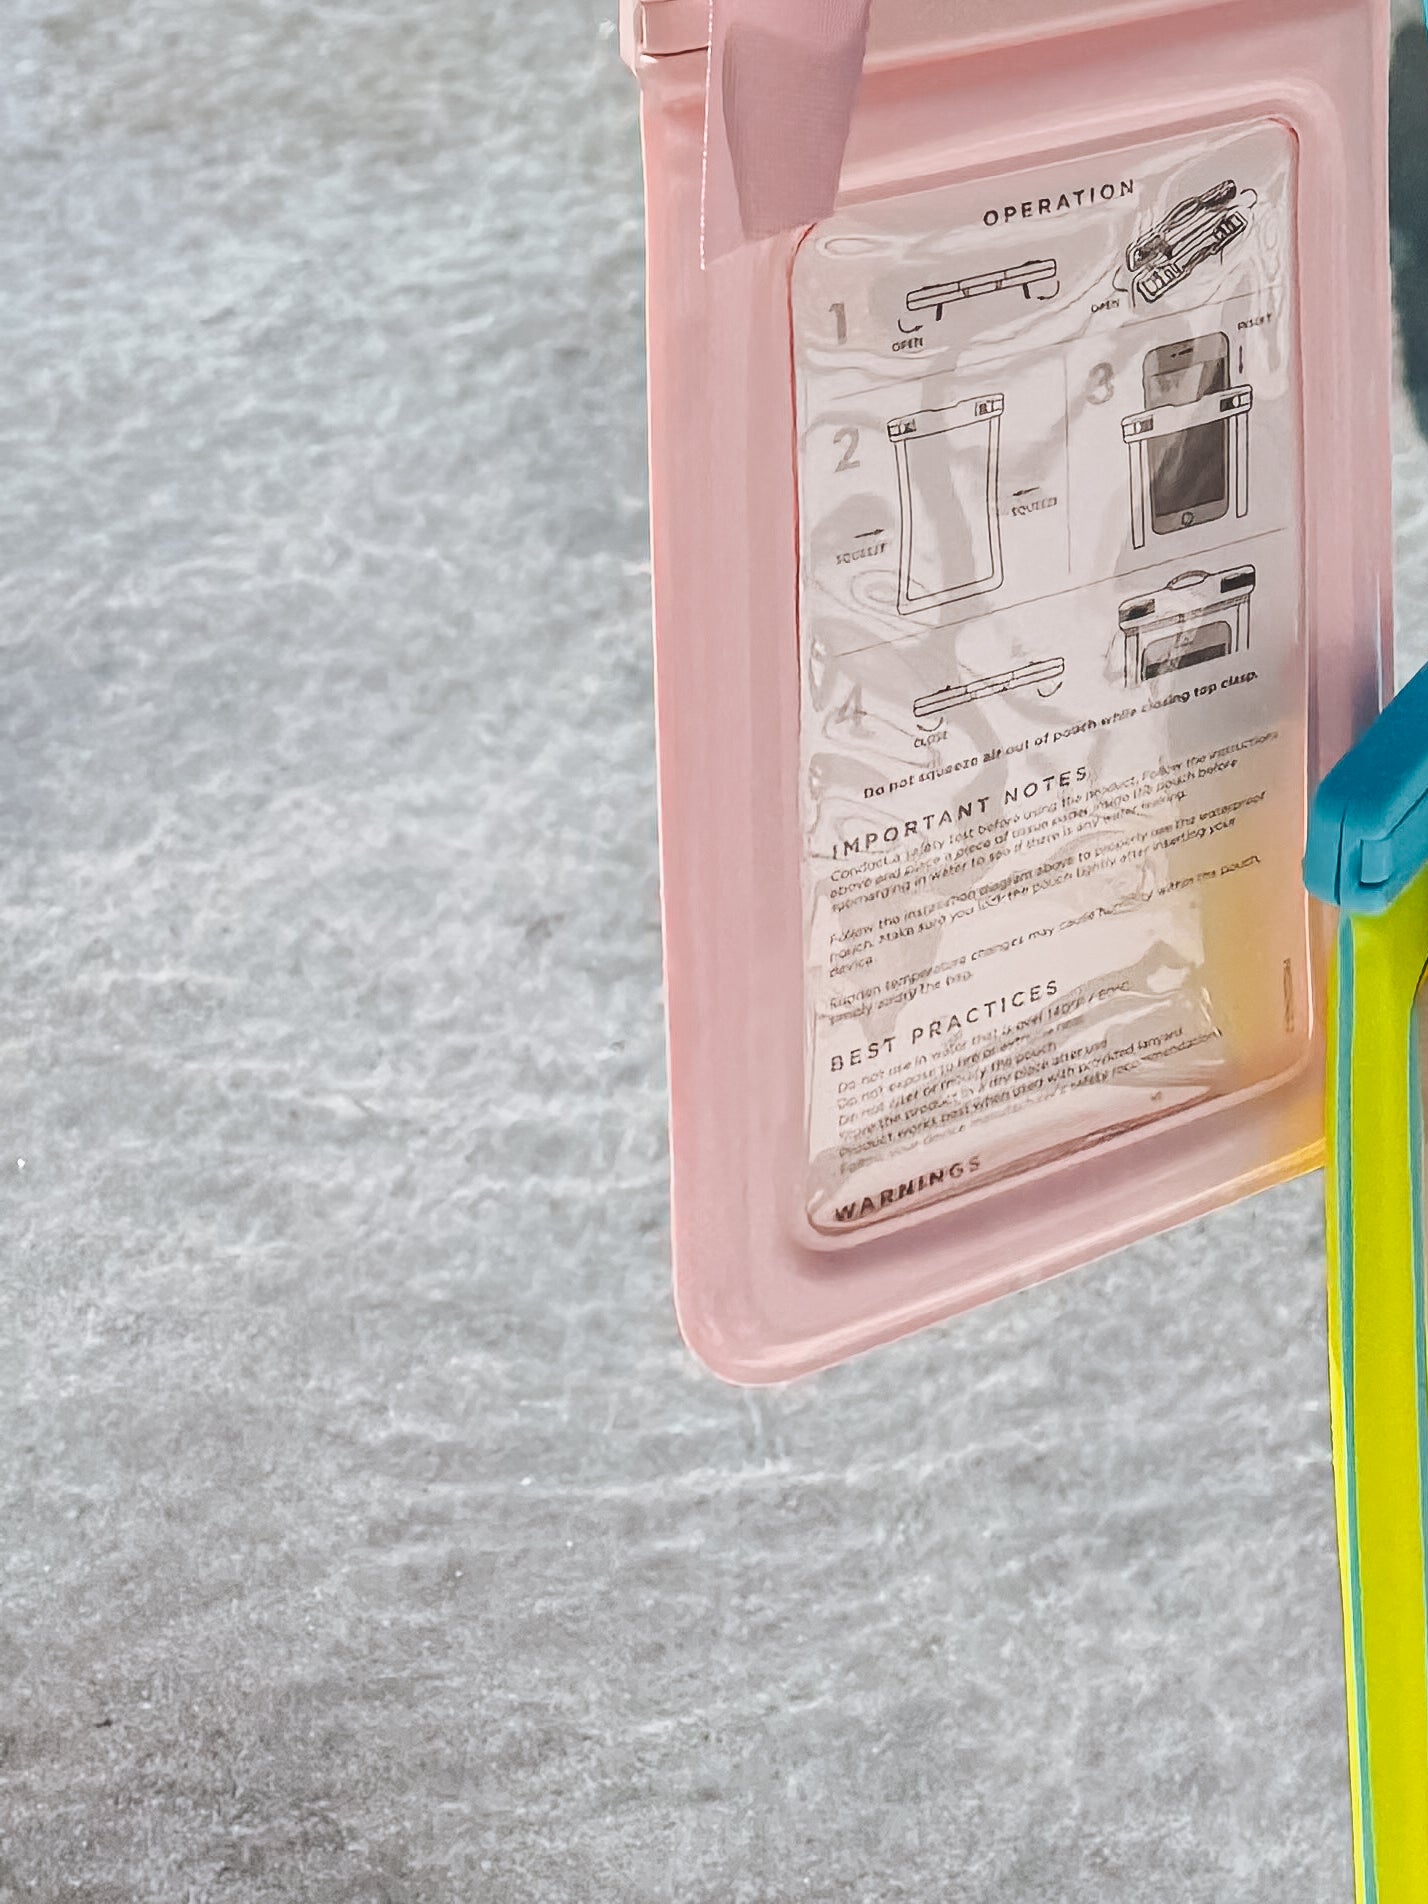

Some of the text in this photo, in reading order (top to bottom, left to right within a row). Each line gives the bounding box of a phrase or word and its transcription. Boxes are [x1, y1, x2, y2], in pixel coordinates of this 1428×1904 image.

[983, 179, 1133, 226] OPERATION
[833, 428, 861, 473] 2
[864, 787, 884, 798] Do
[1035, 732, 1049, 746] of
[1194, 684, 1217, 697] top
[832, 766, 1086, 860] IMPORTANT NOTES
[831, 980, 1057, 1072] BEST PRACTICES
[835, 1157, 980, 1222] WARNINGS
